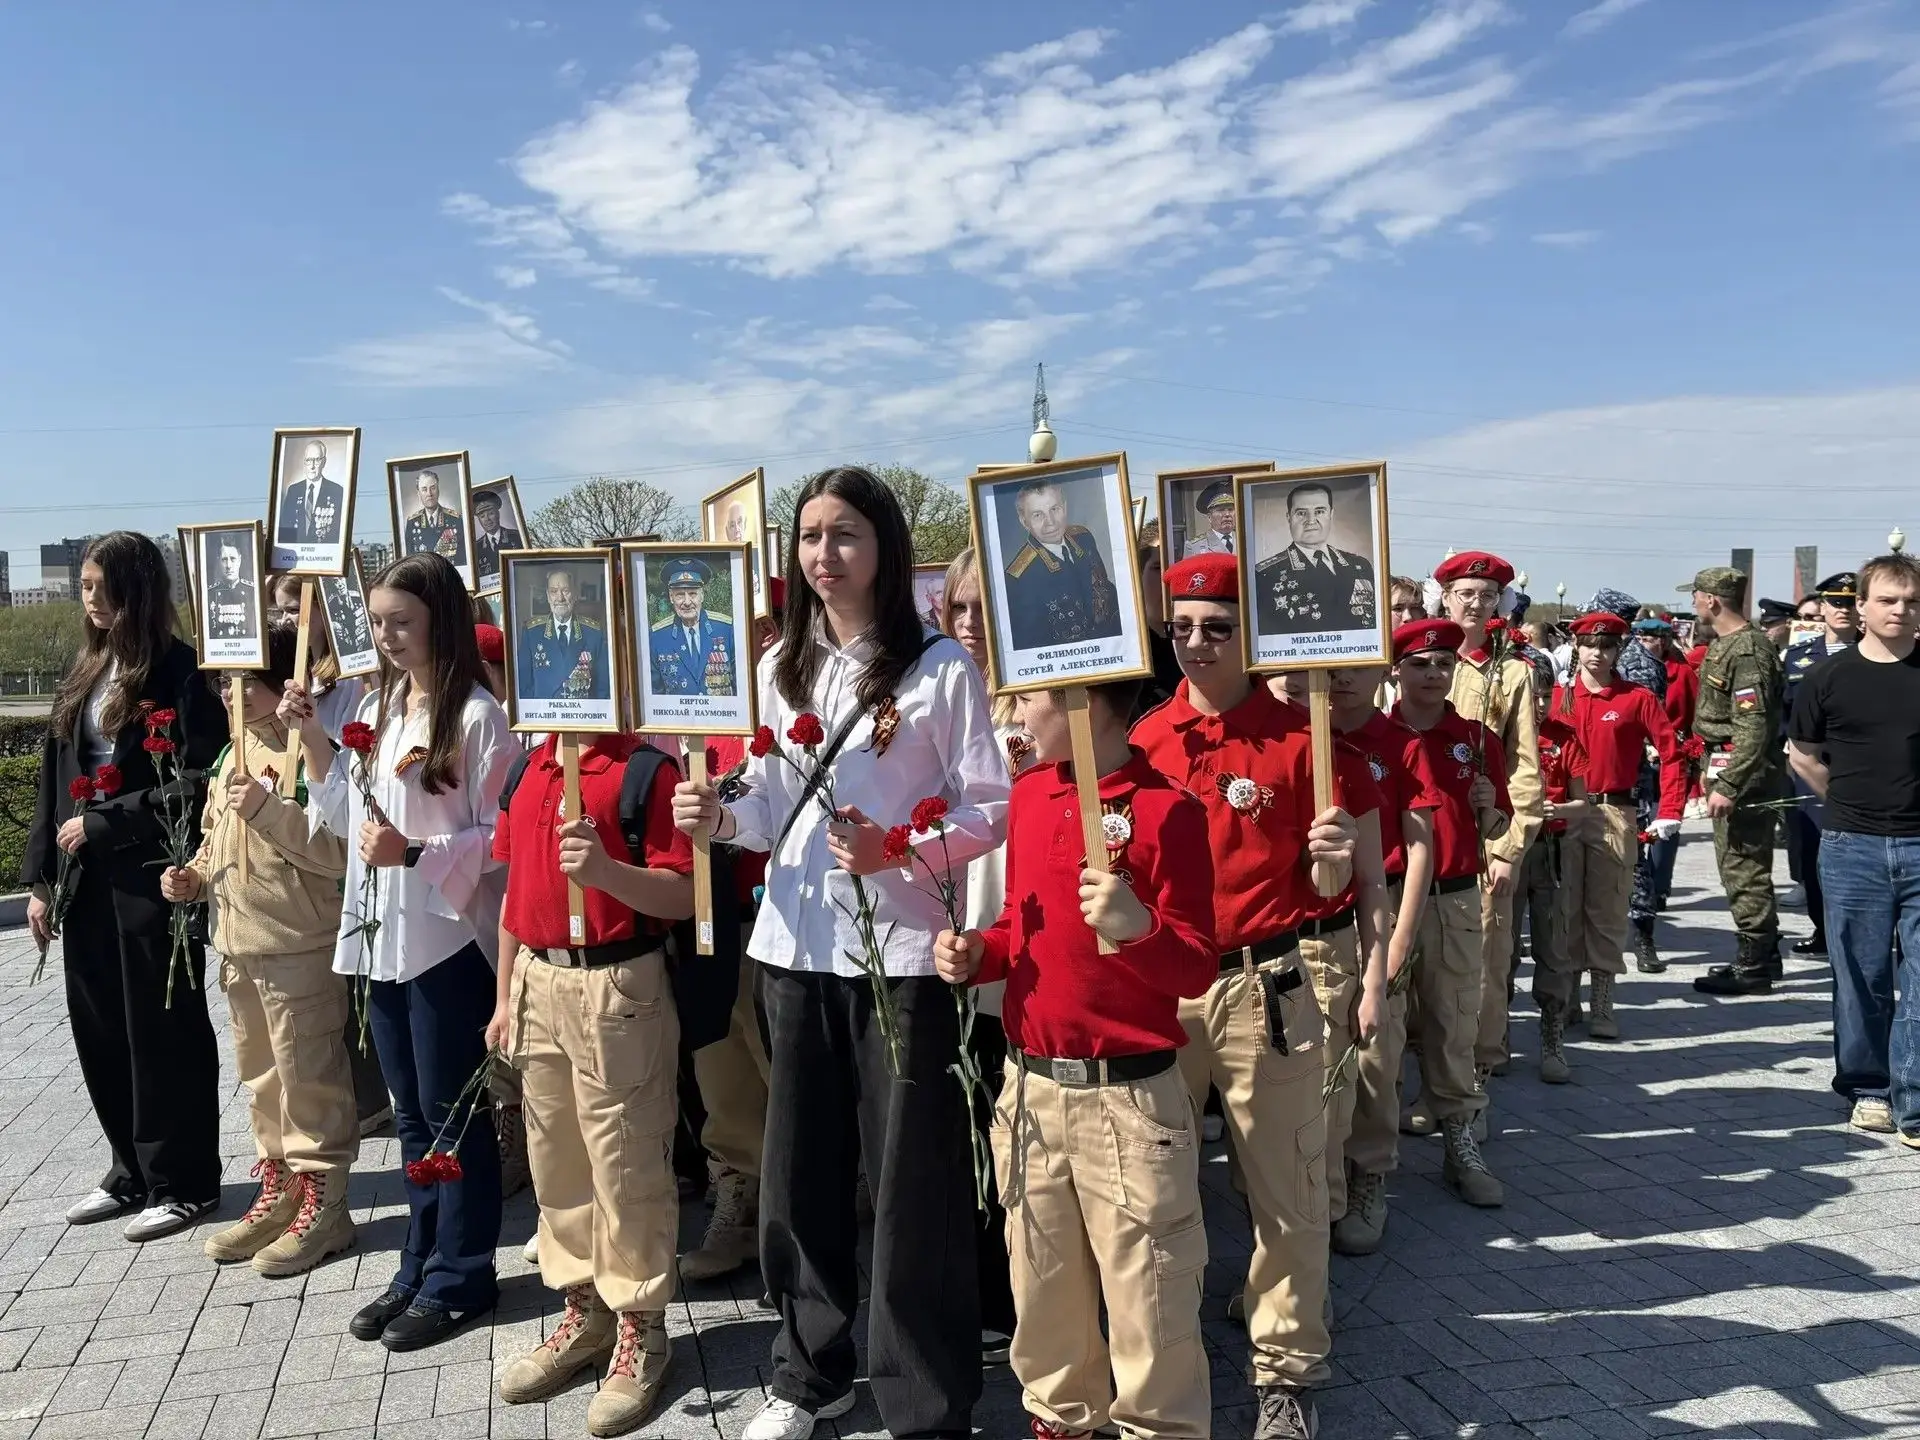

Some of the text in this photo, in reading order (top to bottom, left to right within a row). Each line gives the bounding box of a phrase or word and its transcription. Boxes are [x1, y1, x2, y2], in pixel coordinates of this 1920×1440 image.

[1291, 634, 1342, 644] МИХАЙЛОВ
[1037, 645, 1101, 660] ФИЛИМОНОВ
[1257, 645, 1379, 657] ГЕОРГИЙ АЛЕКСАНДРОВИЧ
[1017, 655, 1124, 676] СЕРГЕЙ АЛЕКСЕЕВИЧ
[653, 708, 737, 717] НИКОЛАЙ НАУМОВИЧ
